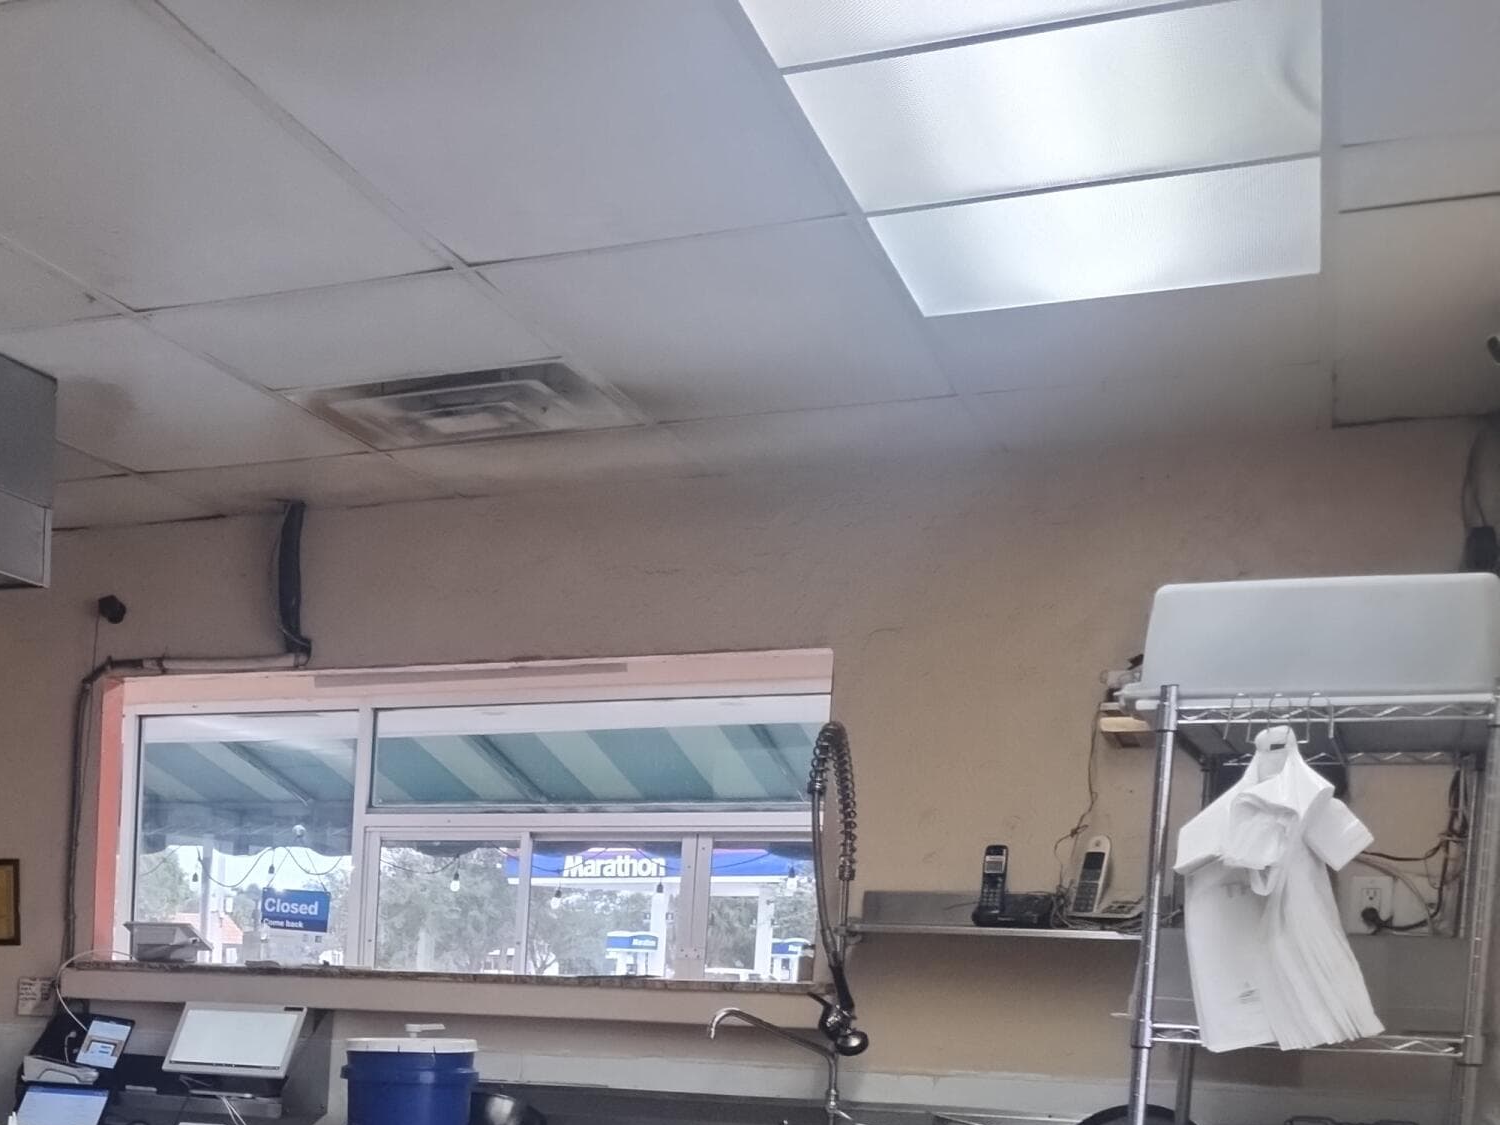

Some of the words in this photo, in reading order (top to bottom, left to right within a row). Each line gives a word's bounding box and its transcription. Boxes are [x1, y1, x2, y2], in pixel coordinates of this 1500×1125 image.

[563, 854, 665, 877] Marathon
[264, 897, 319, 915] Closed
[285, 919, 304, 929] back
